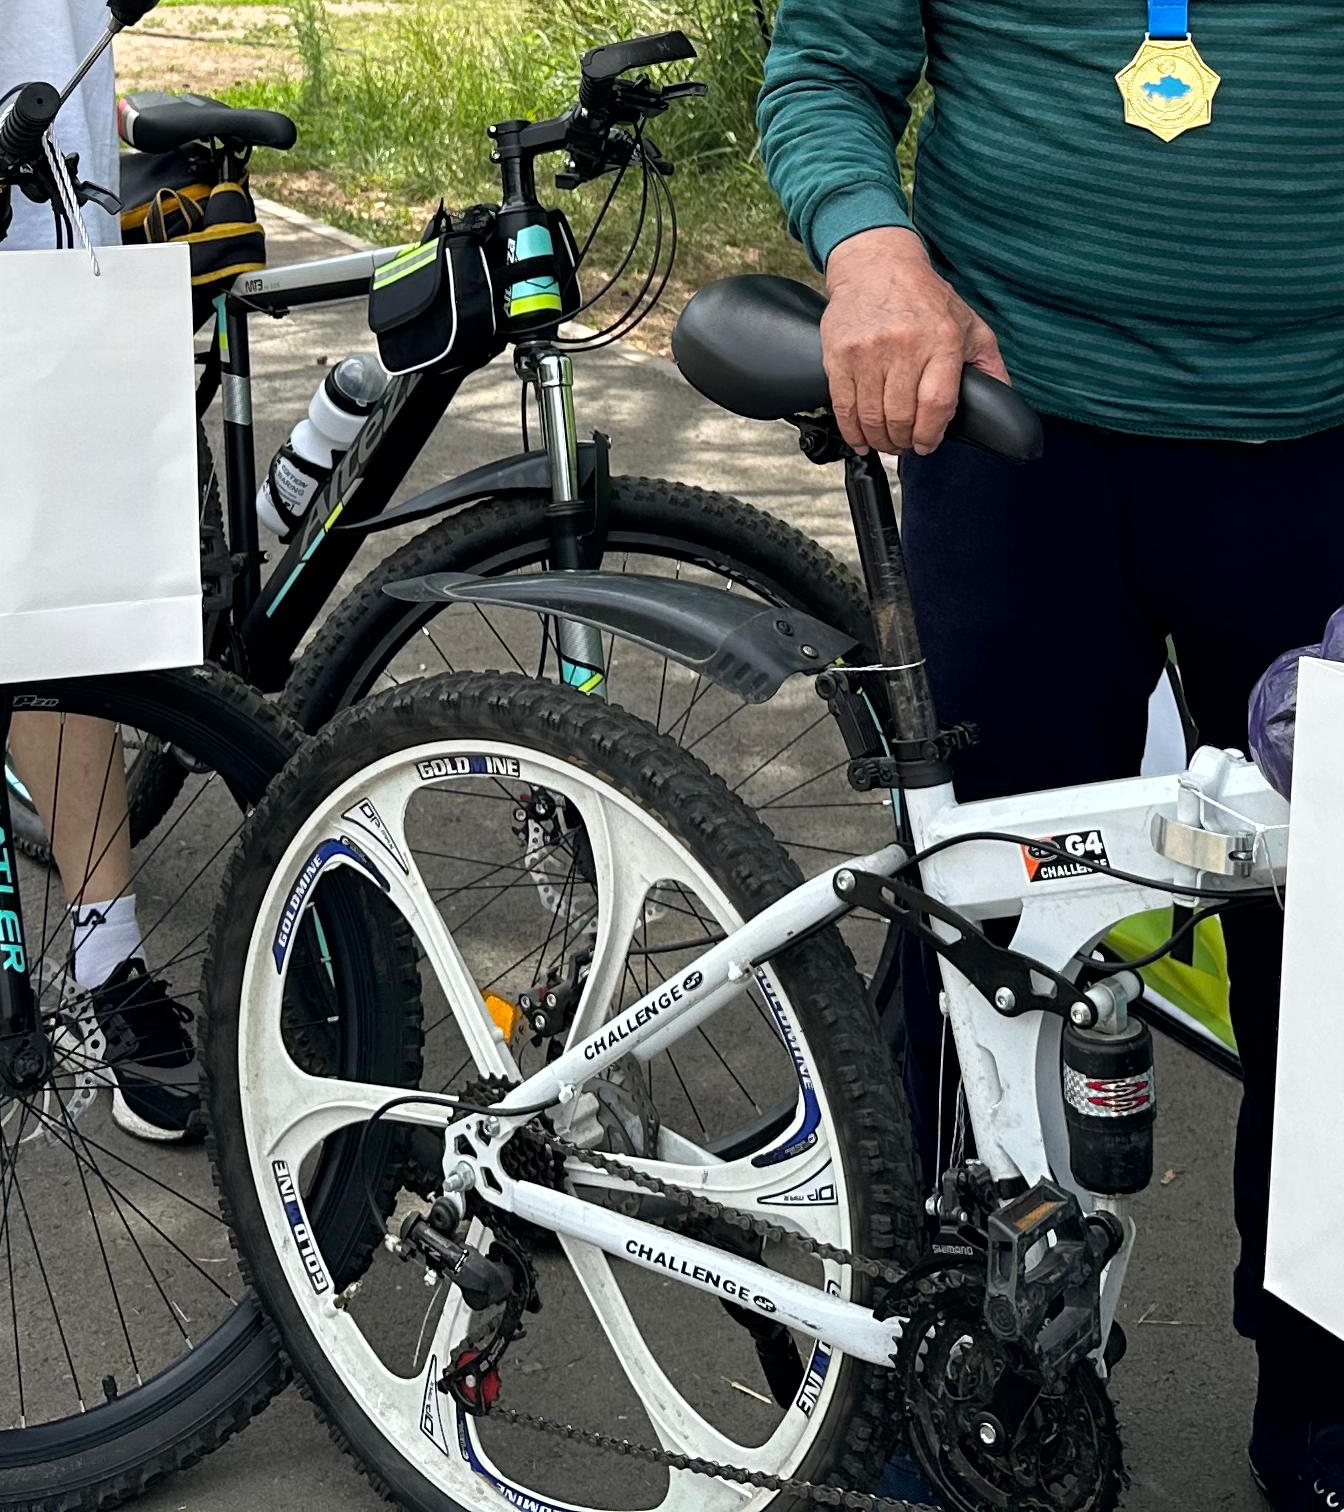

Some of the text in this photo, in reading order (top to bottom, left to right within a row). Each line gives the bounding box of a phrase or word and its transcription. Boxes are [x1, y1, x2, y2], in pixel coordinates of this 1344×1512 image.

[416, 756, 520, 779] GOLDMINE
[1064, 831, 1103, 857] G4
[278, 853, 323, 948] GOLDMINE
[583, 984, 684, 1061] CHALLENGE
[274, 1160, 329, 1291] GOLDMINE
[931, 1243, 975, 1256] SHIMANO
[625, 1239, 751, 1302] CHALLENGE
